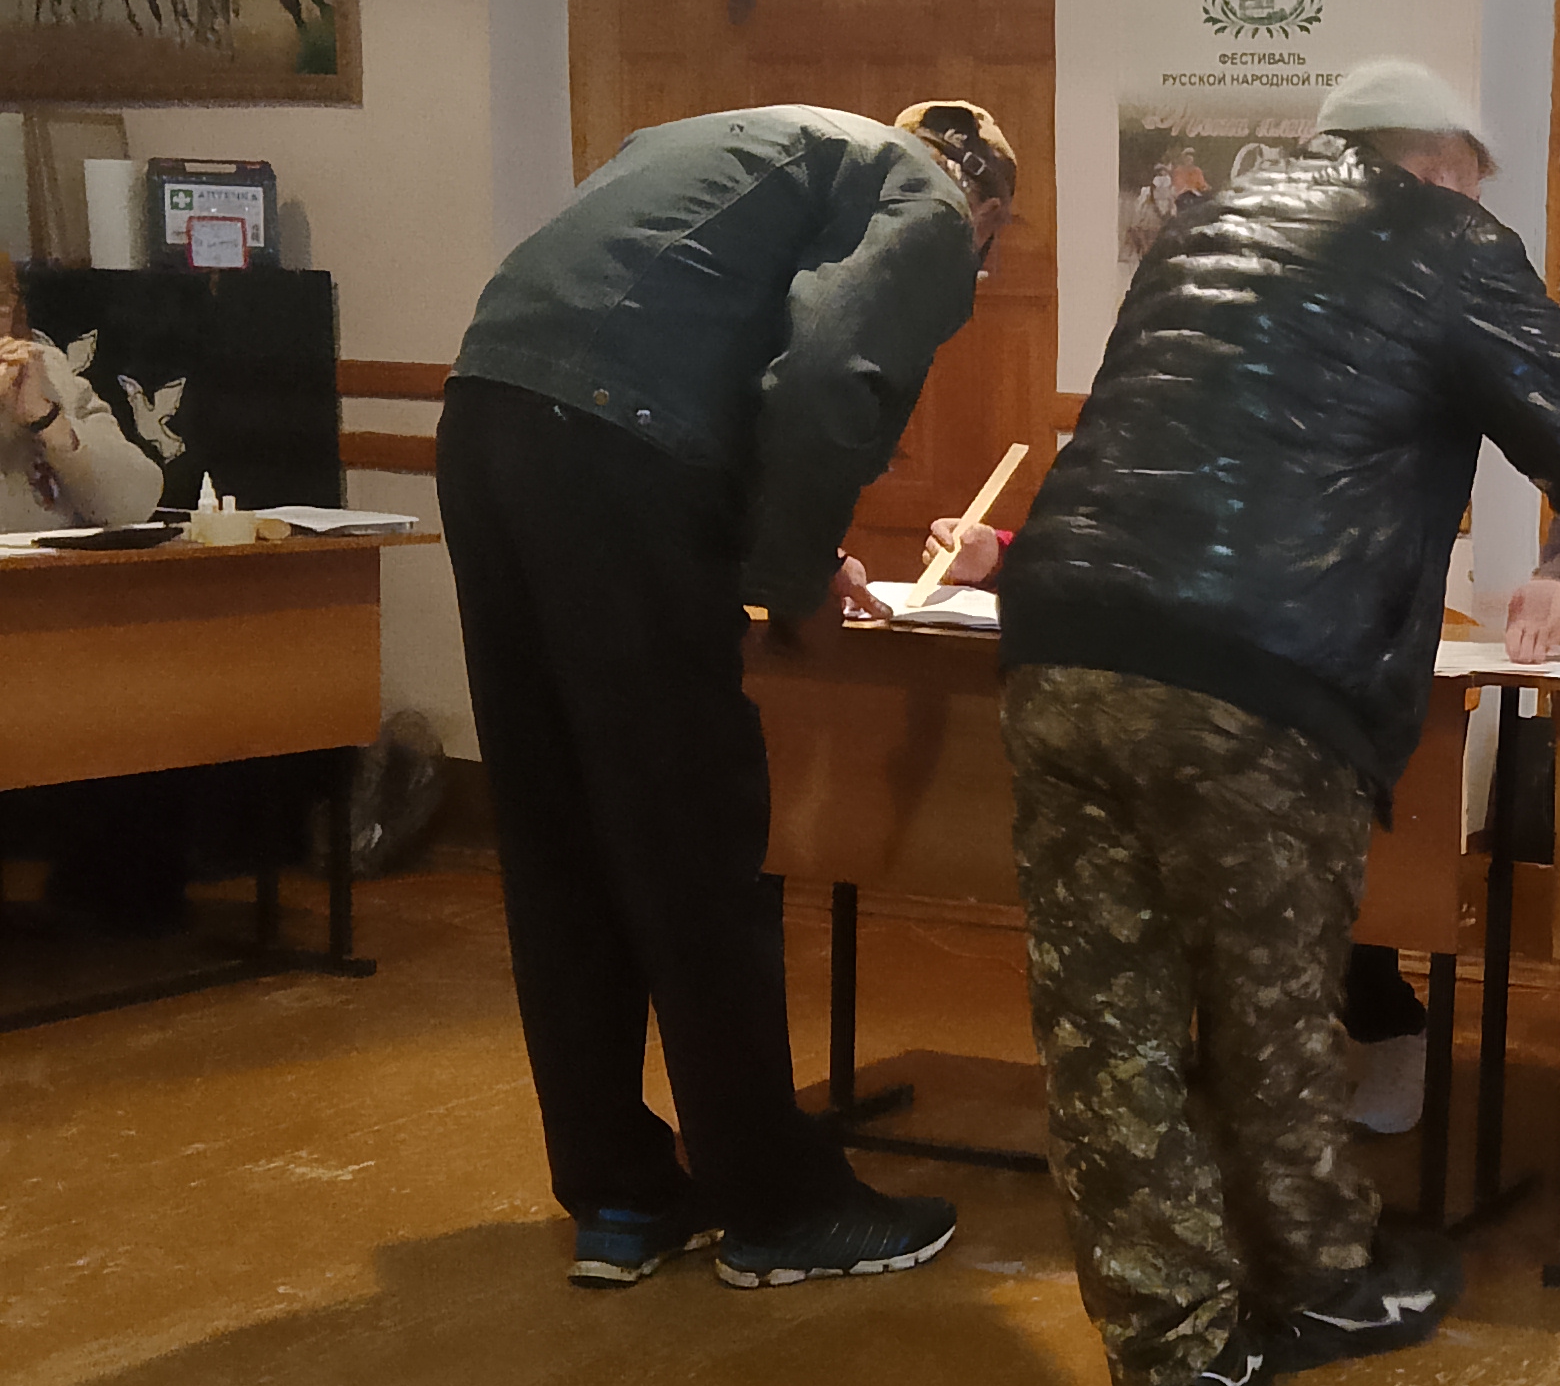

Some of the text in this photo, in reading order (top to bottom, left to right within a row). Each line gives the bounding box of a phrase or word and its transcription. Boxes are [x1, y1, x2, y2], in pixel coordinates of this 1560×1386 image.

[1218, 52, 1307, 66] ФЕСТИВАЛЬ
[1162, 71, 1345, 88] РУССКОЙ НАРОДНОЙ ПЕС
